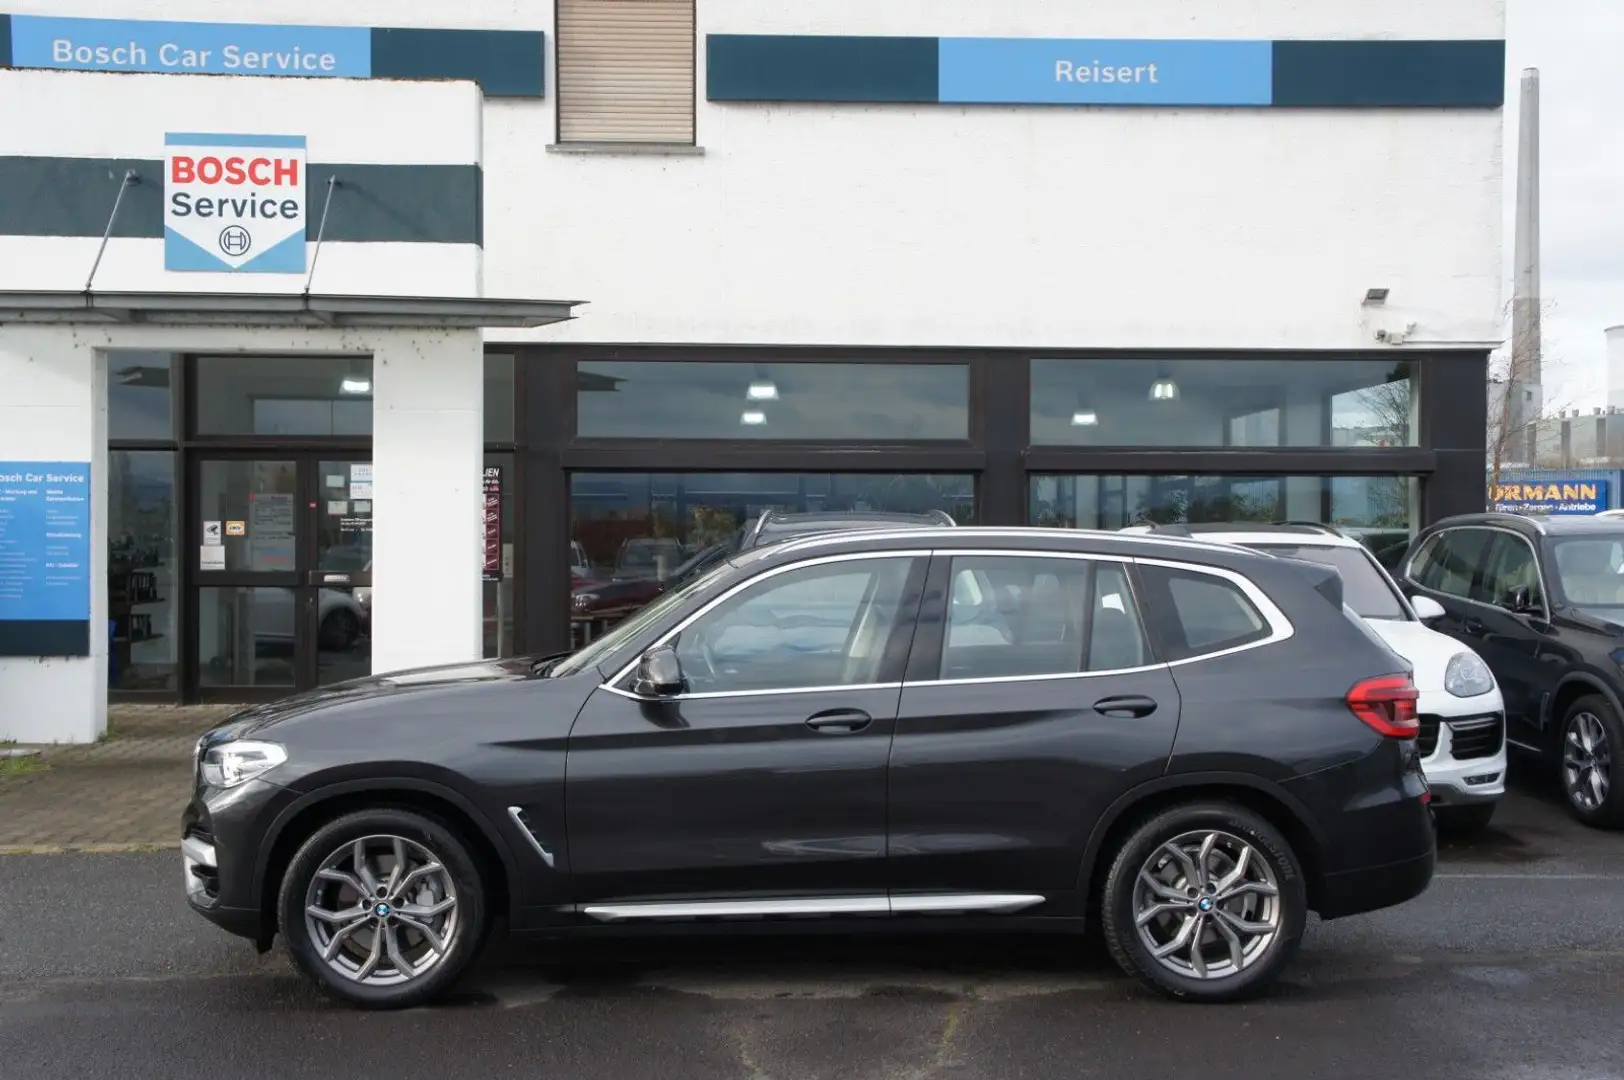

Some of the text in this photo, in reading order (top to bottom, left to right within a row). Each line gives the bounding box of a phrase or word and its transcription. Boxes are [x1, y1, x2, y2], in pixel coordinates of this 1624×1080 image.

[52, 38, 337, 71] Bosch Car Service
[1054, 59, 1159, 83] Reisert
[171, 156, 298, 186] BOSCH
[171, 192, 299, 219] Service
[25, 472, 44, 483] Car
[46, 472, 85, 483] Service
[1558, 502, 1596, 511] Antriebe
